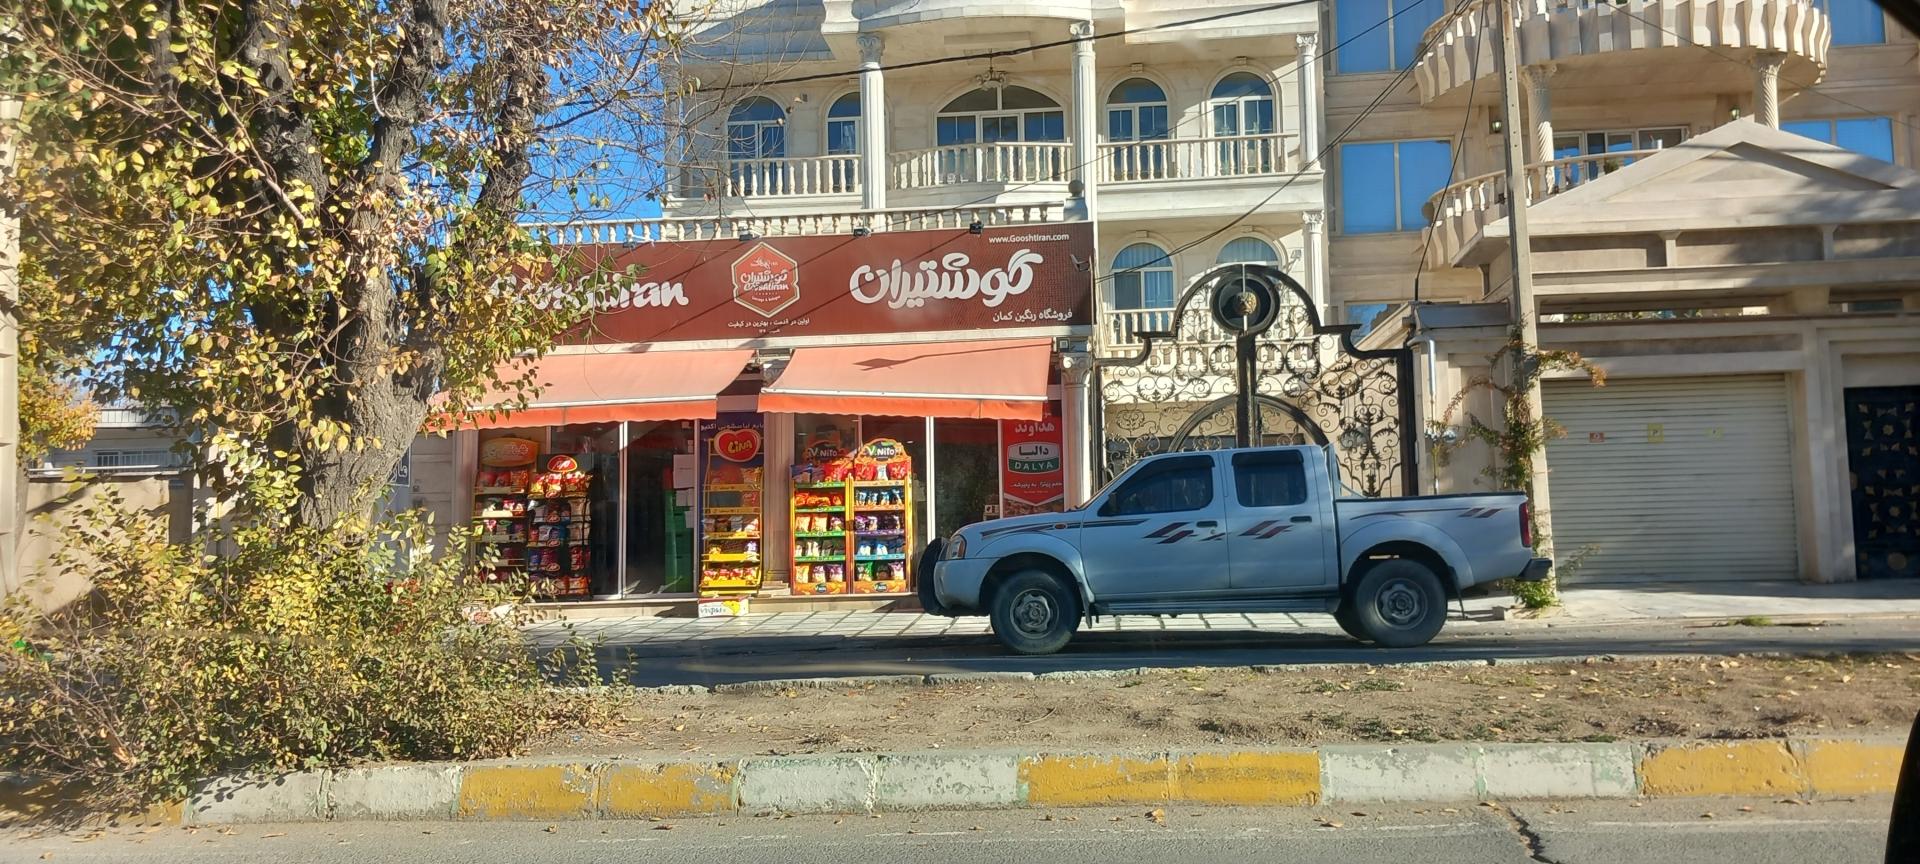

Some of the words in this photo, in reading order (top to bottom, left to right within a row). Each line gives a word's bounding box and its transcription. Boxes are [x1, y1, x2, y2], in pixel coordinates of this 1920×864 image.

[849, 249, 1044, 309] گوشتیران
[992, 310, 1014, 322] کمان
[1014, 309, 1037, 322] رنگین
[1038, 308, 1073, 320] فروشگاه
[727, 320, 744, 328] کیفیت
[797, 317, 810, 326] اولین
[1018, 445, 1049, 459] دالیا
[1014, 461, 1053, 471] DALYA
